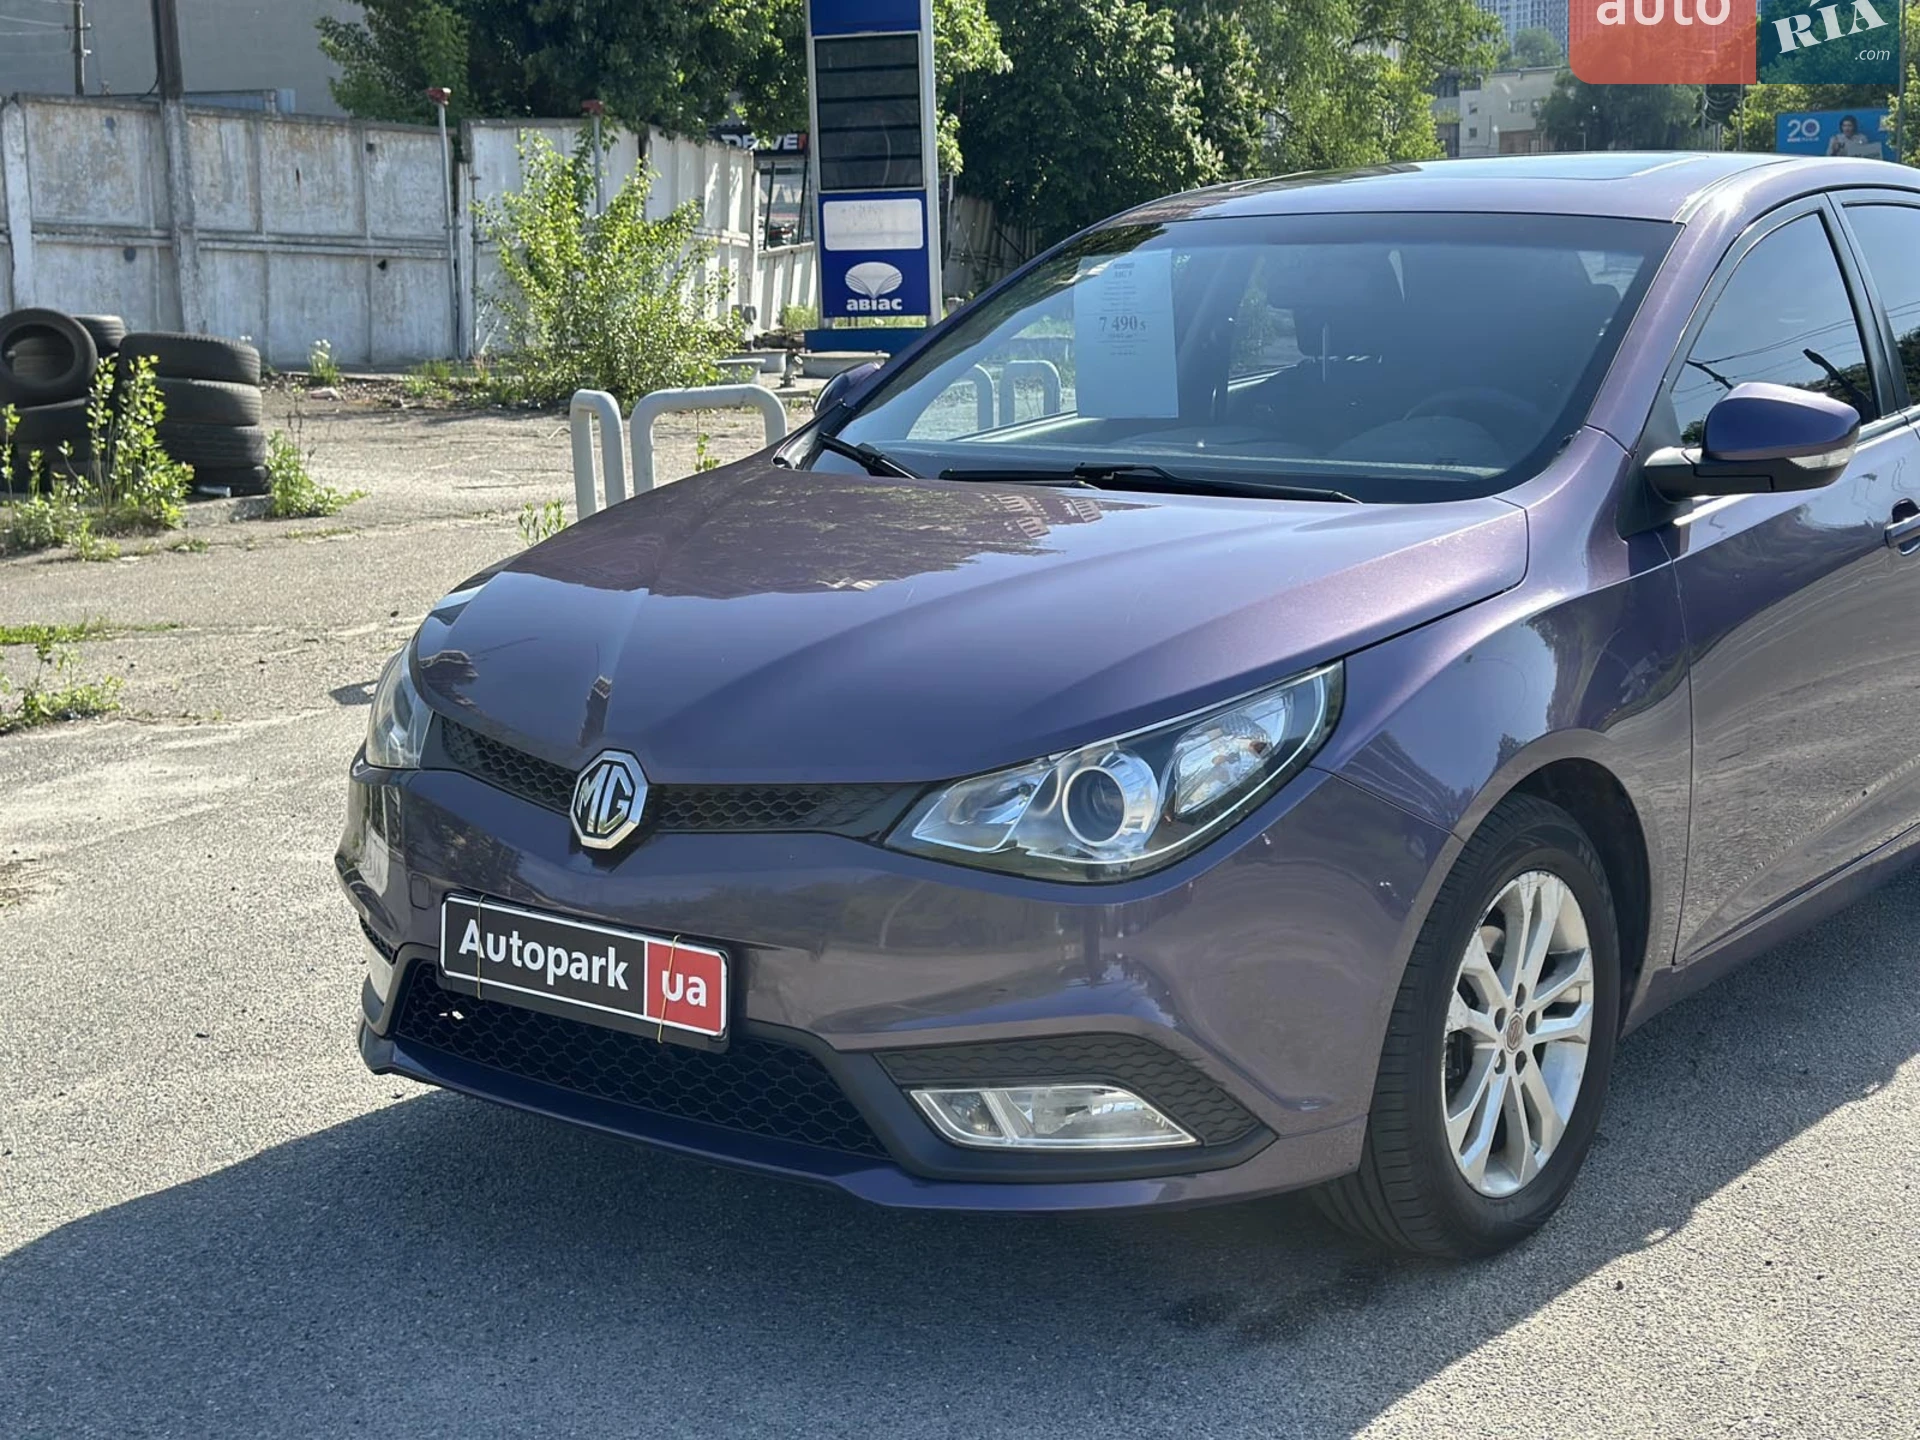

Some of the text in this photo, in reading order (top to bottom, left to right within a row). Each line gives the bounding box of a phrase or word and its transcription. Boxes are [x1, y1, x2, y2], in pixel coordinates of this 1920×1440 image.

[1787, 118, 1820, 138] 20
[1111, 315, 1138, 331] 490
[577, 763, 633, 835] MG
[458, 918, 708, 1008] Autopark ua
